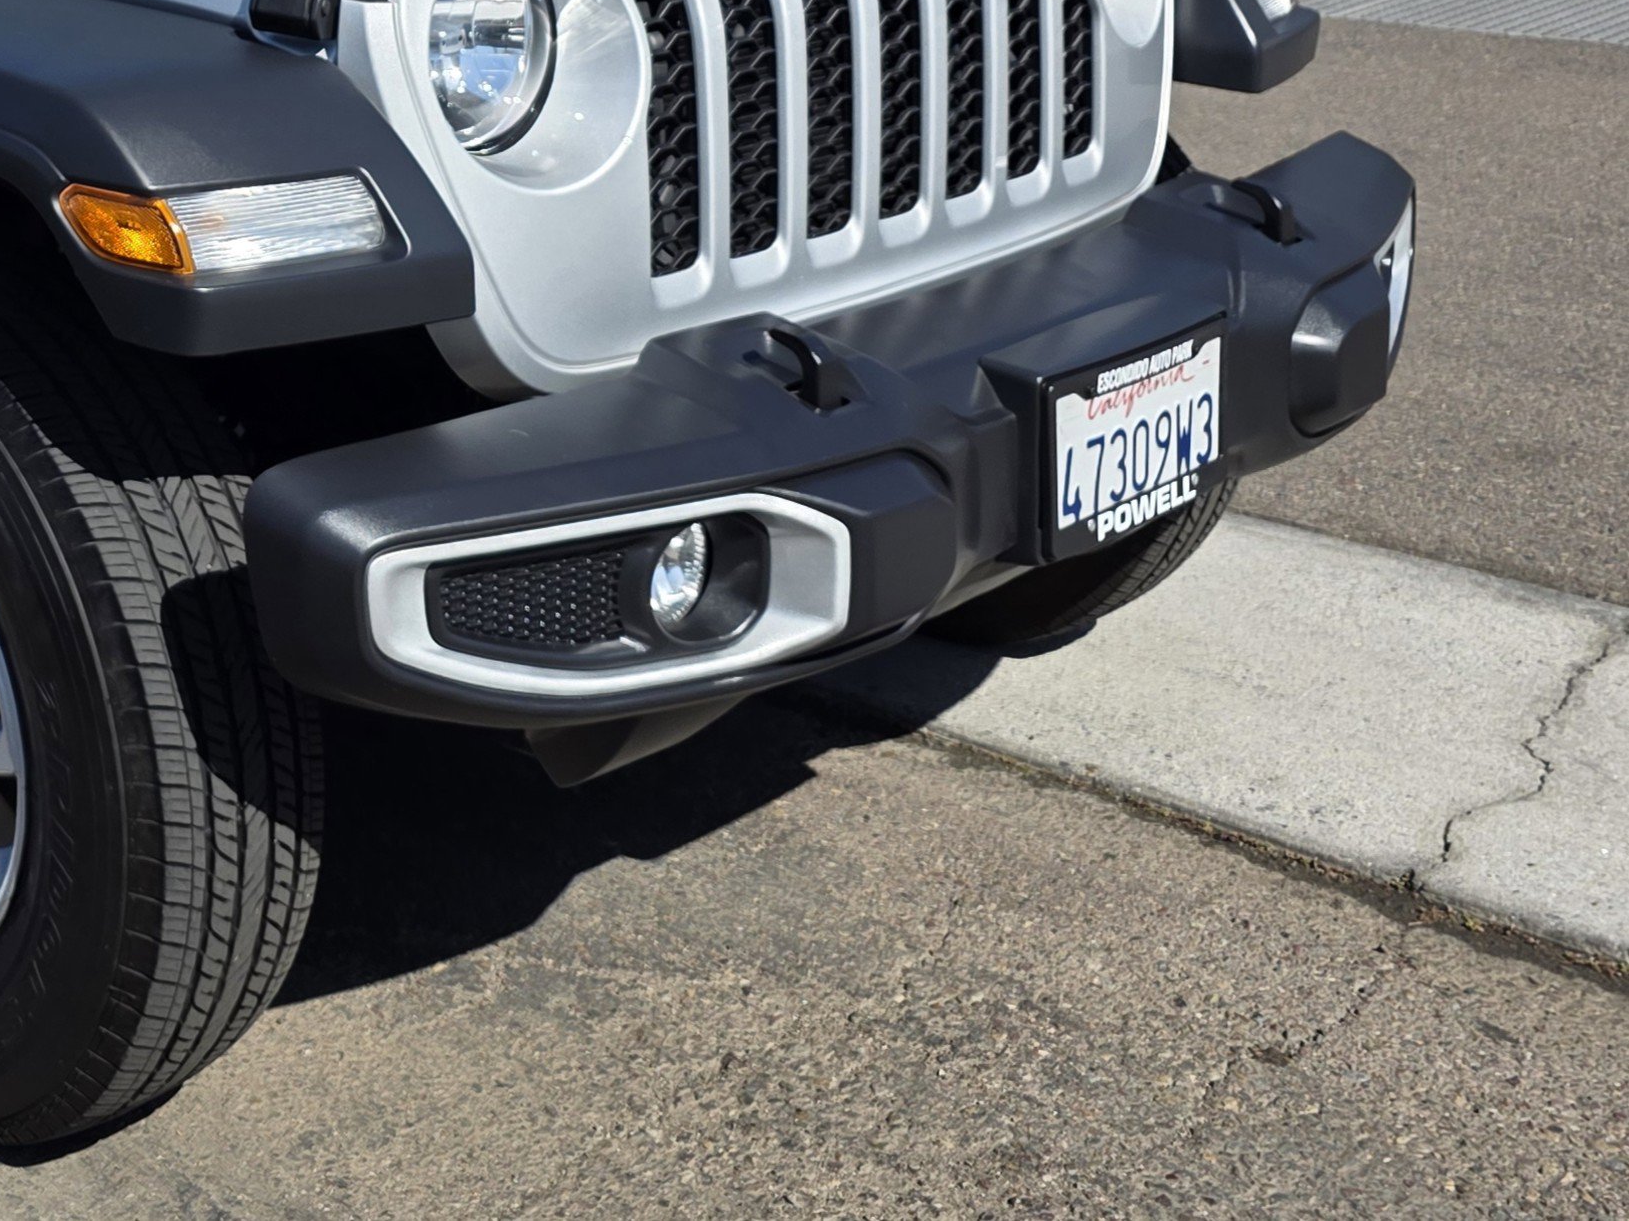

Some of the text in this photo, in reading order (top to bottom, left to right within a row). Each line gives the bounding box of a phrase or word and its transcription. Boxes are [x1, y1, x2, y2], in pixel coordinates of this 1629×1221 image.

[1088, 364, 1196, 420] California
[1062, 392, 1213, 521] 47309W3
[1097, 473, 1197, 542] POWELL
